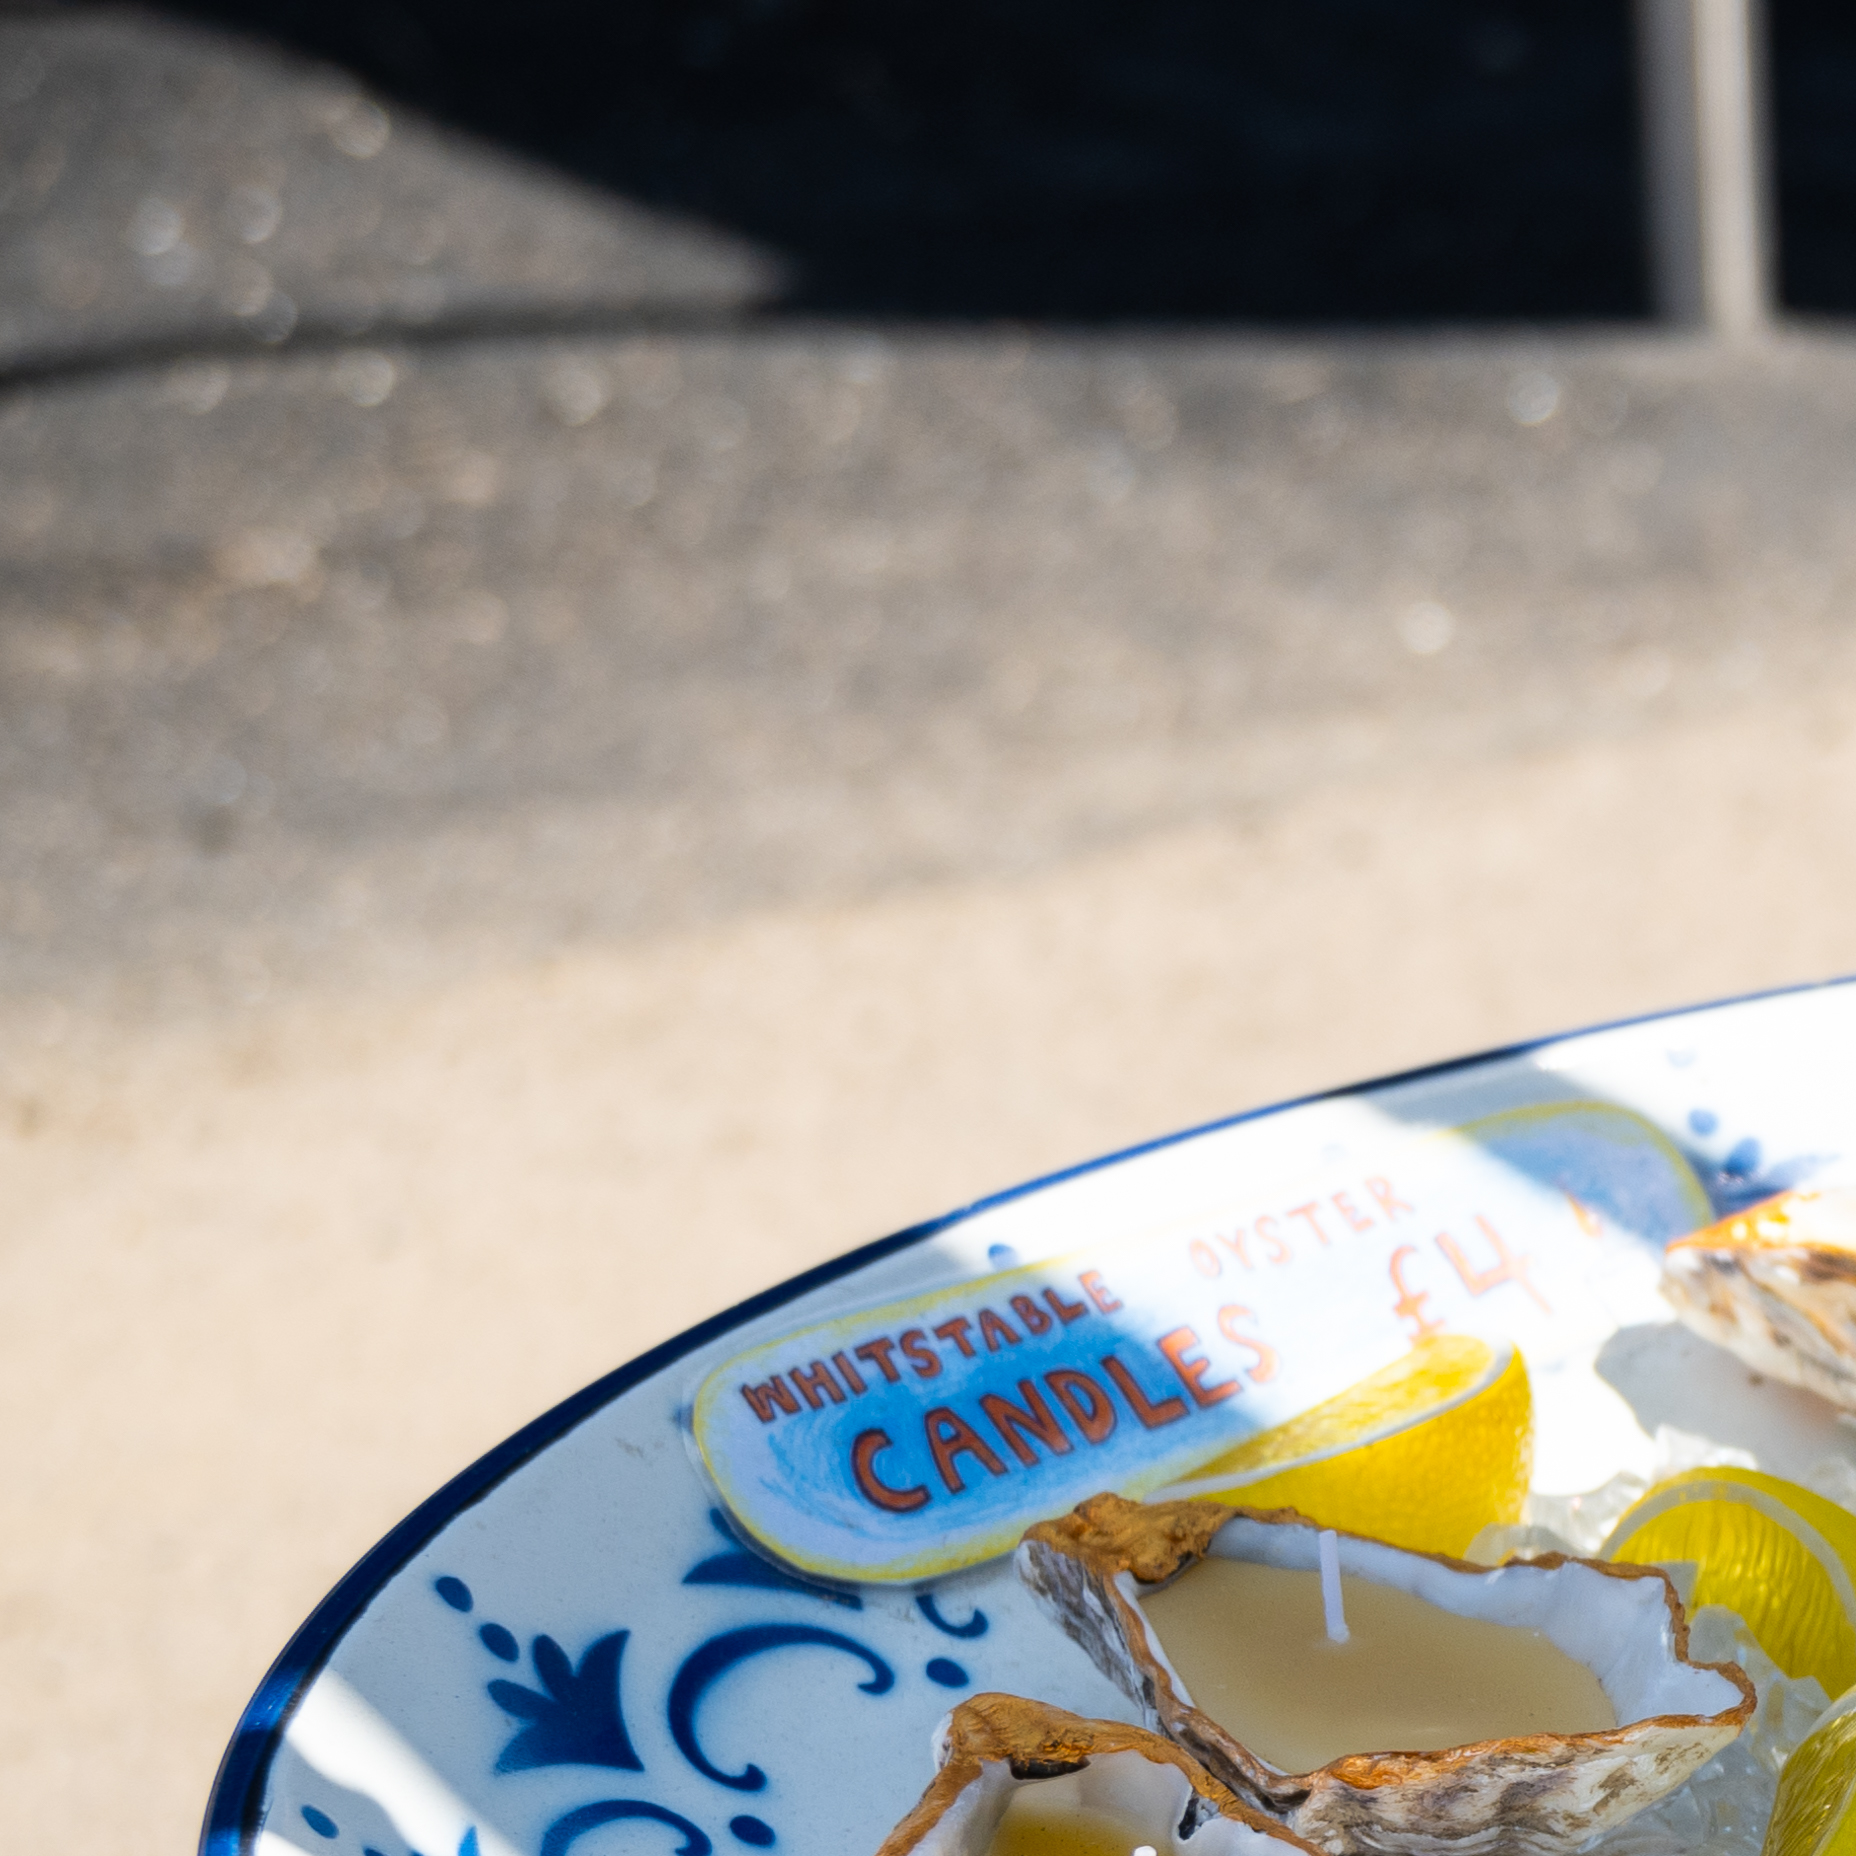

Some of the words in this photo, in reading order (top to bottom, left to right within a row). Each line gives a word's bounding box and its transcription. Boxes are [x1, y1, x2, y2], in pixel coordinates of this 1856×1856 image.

[740, 1270, 1122, 1424] WHITSTABLE
[1188, 1175, 1416, 1278] OYSTER
[851, 1304, 1281, 1513] CANDLES
[1389, 1212, 1554, 1347] £4
